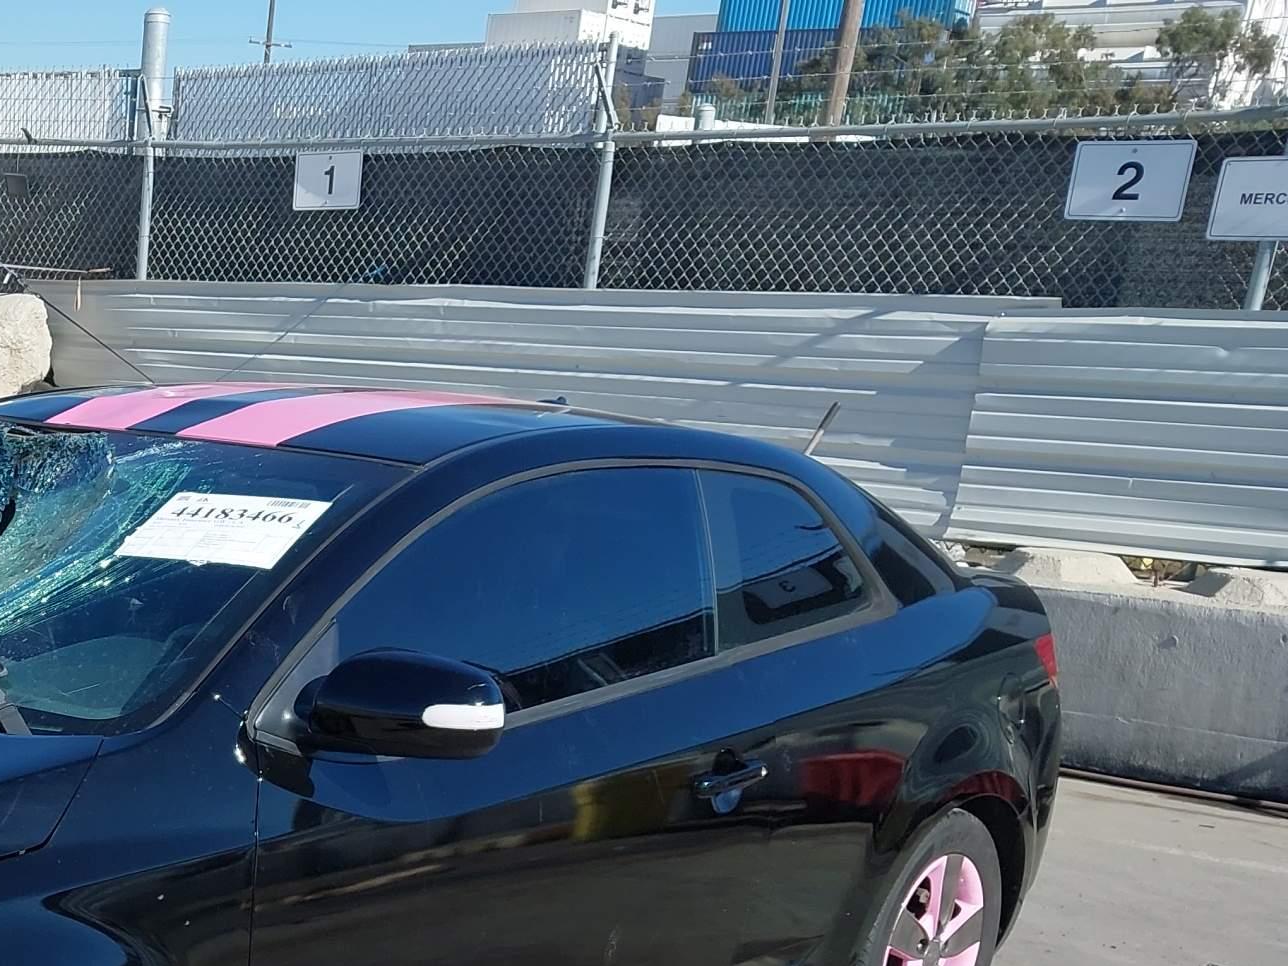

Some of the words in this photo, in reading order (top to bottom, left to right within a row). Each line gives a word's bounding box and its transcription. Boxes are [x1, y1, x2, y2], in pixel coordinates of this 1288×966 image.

[324, 165, 336, 195] 1
[1112, 161, 1145, 201] 2
[1239, 192, 1288, 205] MERC
[171, 506, 297, 524] 44183466
